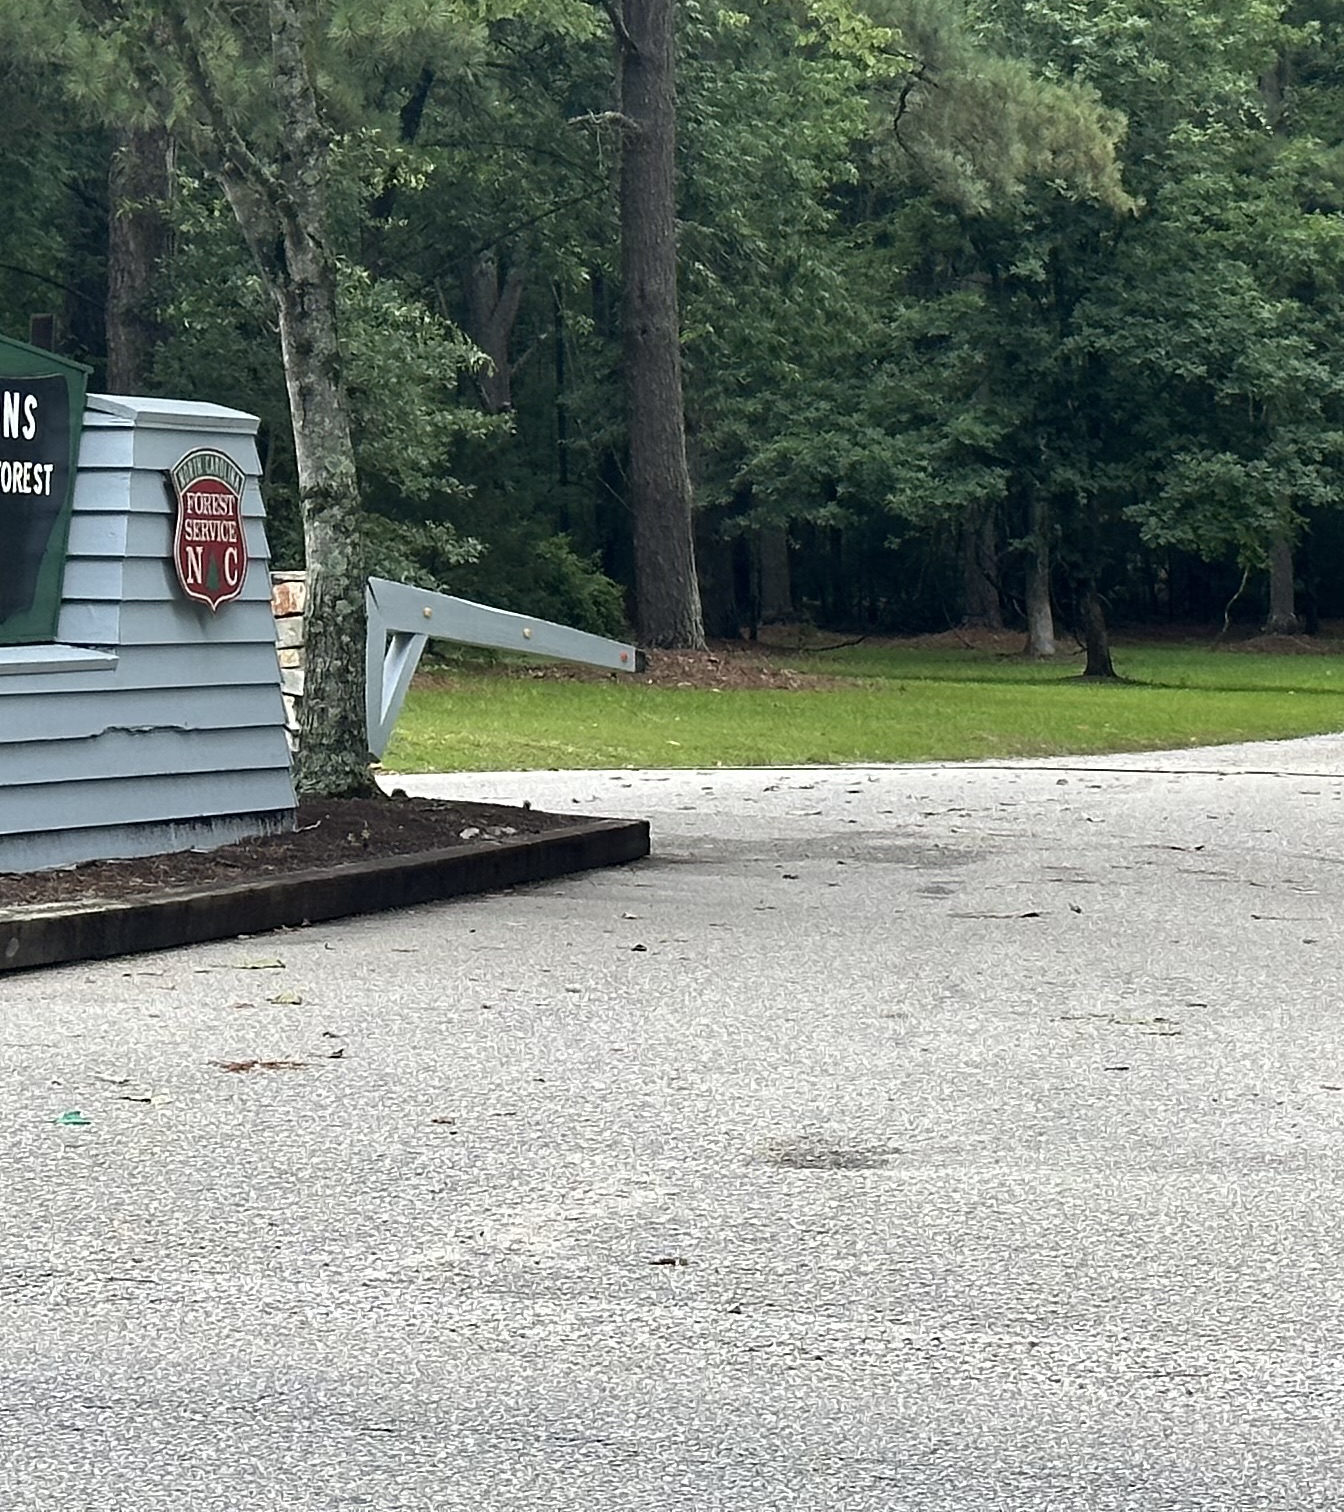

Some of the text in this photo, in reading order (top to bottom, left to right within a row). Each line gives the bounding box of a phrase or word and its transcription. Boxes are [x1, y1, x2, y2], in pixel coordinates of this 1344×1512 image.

[205, 455, 240, 492] CAROLINA
[186, 492, 236, 516] FOREST
[184, 519, 238, 543] SERVICE
[185, 546, 239, 586] N C
